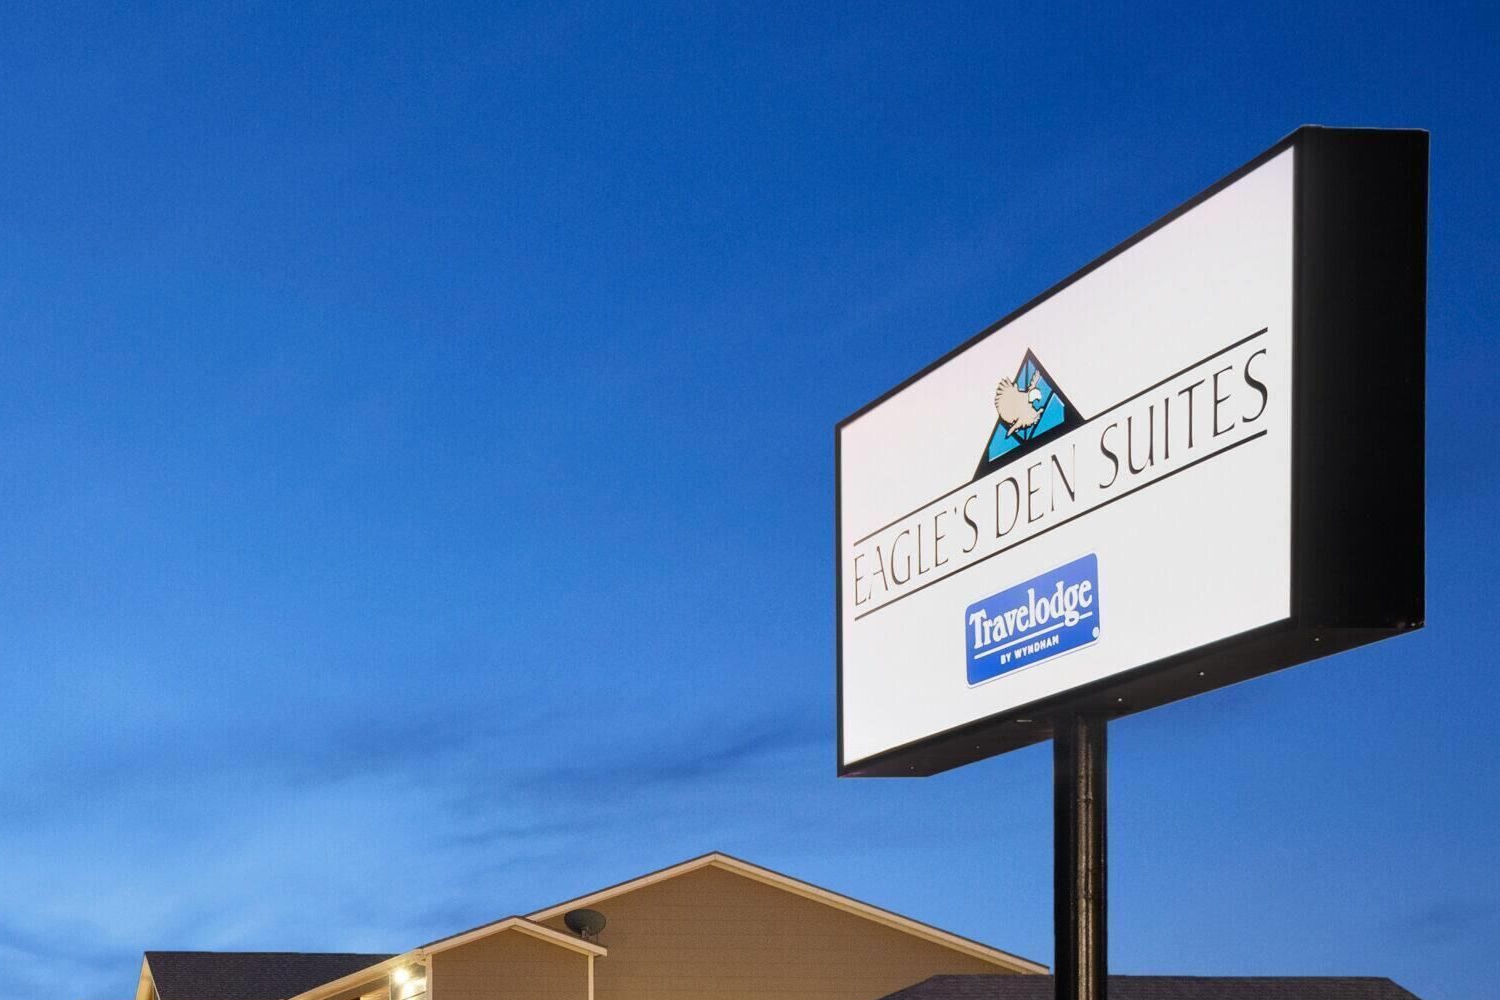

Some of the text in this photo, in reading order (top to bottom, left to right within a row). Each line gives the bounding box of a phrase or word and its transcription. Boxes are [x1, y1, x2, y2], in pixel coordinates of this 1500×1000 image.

[854, 348, 1269, 606] EAGLE'S DEN SUITES
[969, 579, 1093, 650] Travelodge
[1000, 635, 1060, 665] BY WYNDHAM
